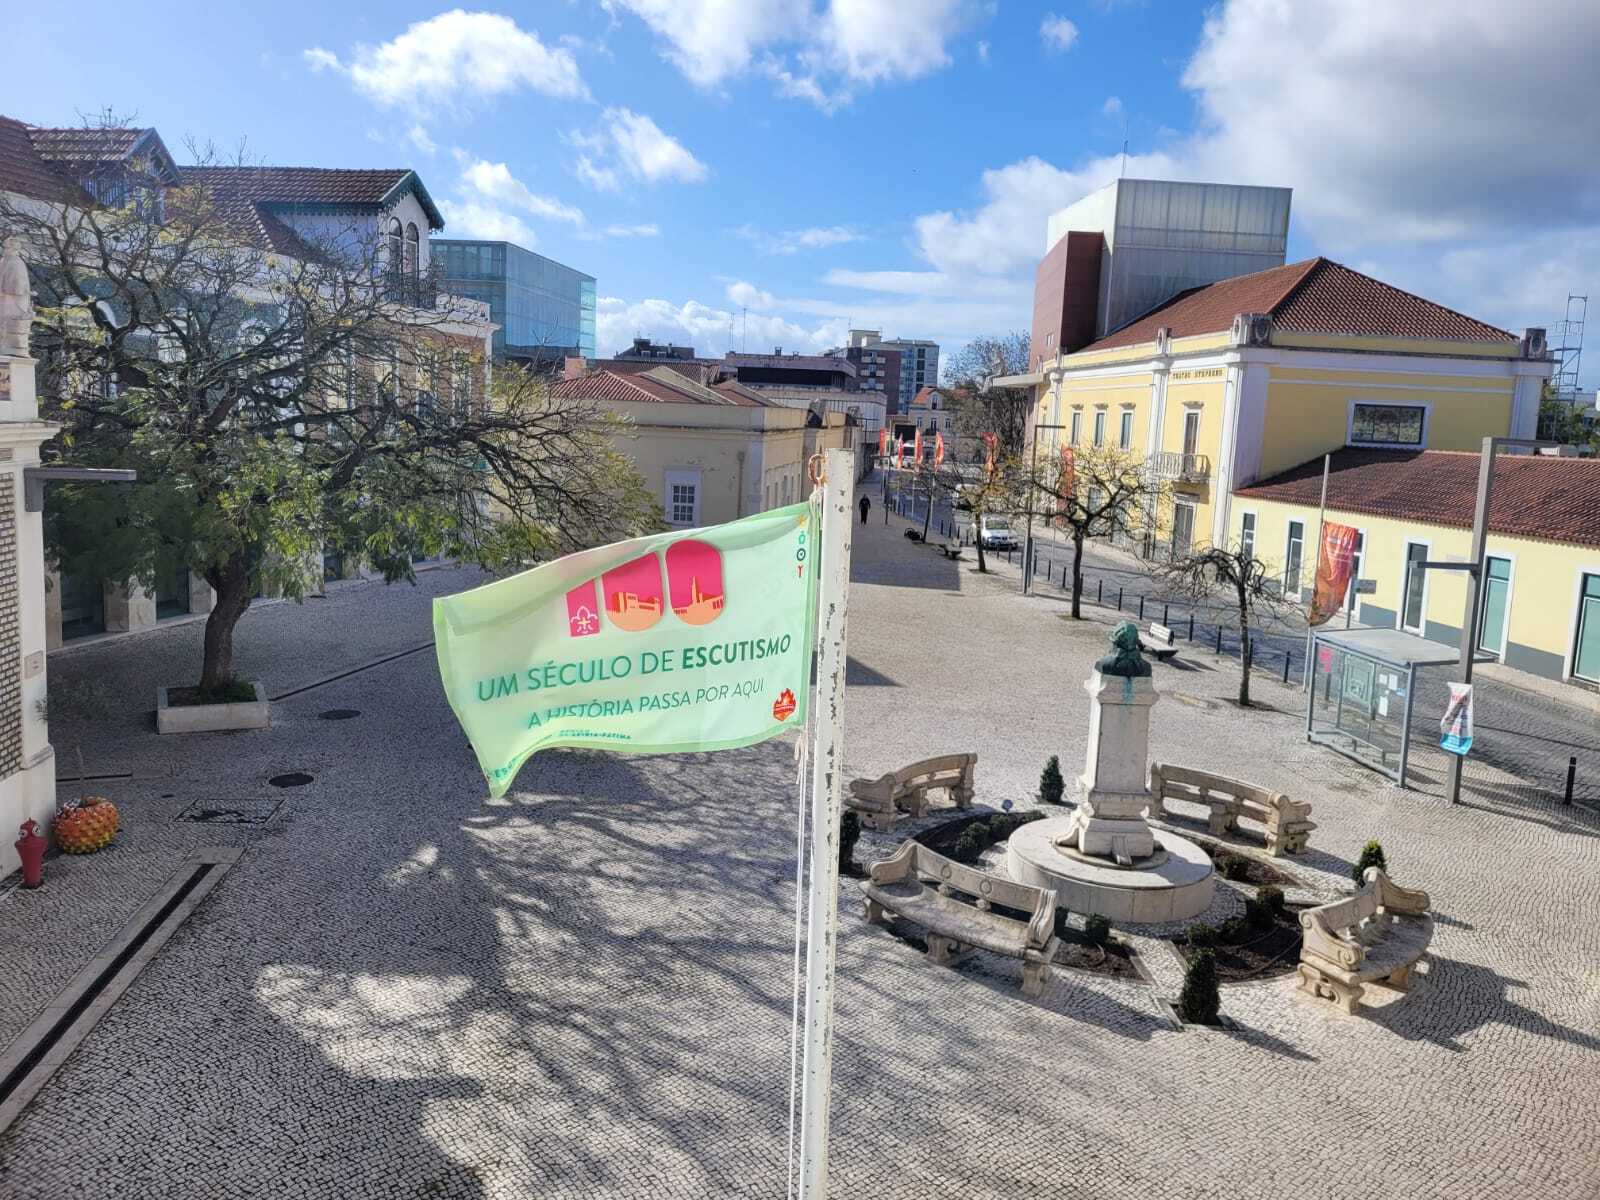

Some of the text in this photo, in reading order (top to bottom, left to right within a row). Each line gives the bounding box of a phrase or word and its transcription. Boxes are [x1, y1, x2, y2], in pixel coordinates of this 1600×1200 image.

[478, 634, 792, 701] UM SÉCULO DE ESCUTISMO
[528, 677, 764, 729] A HISTÓRIA PASSA POR AQUI
